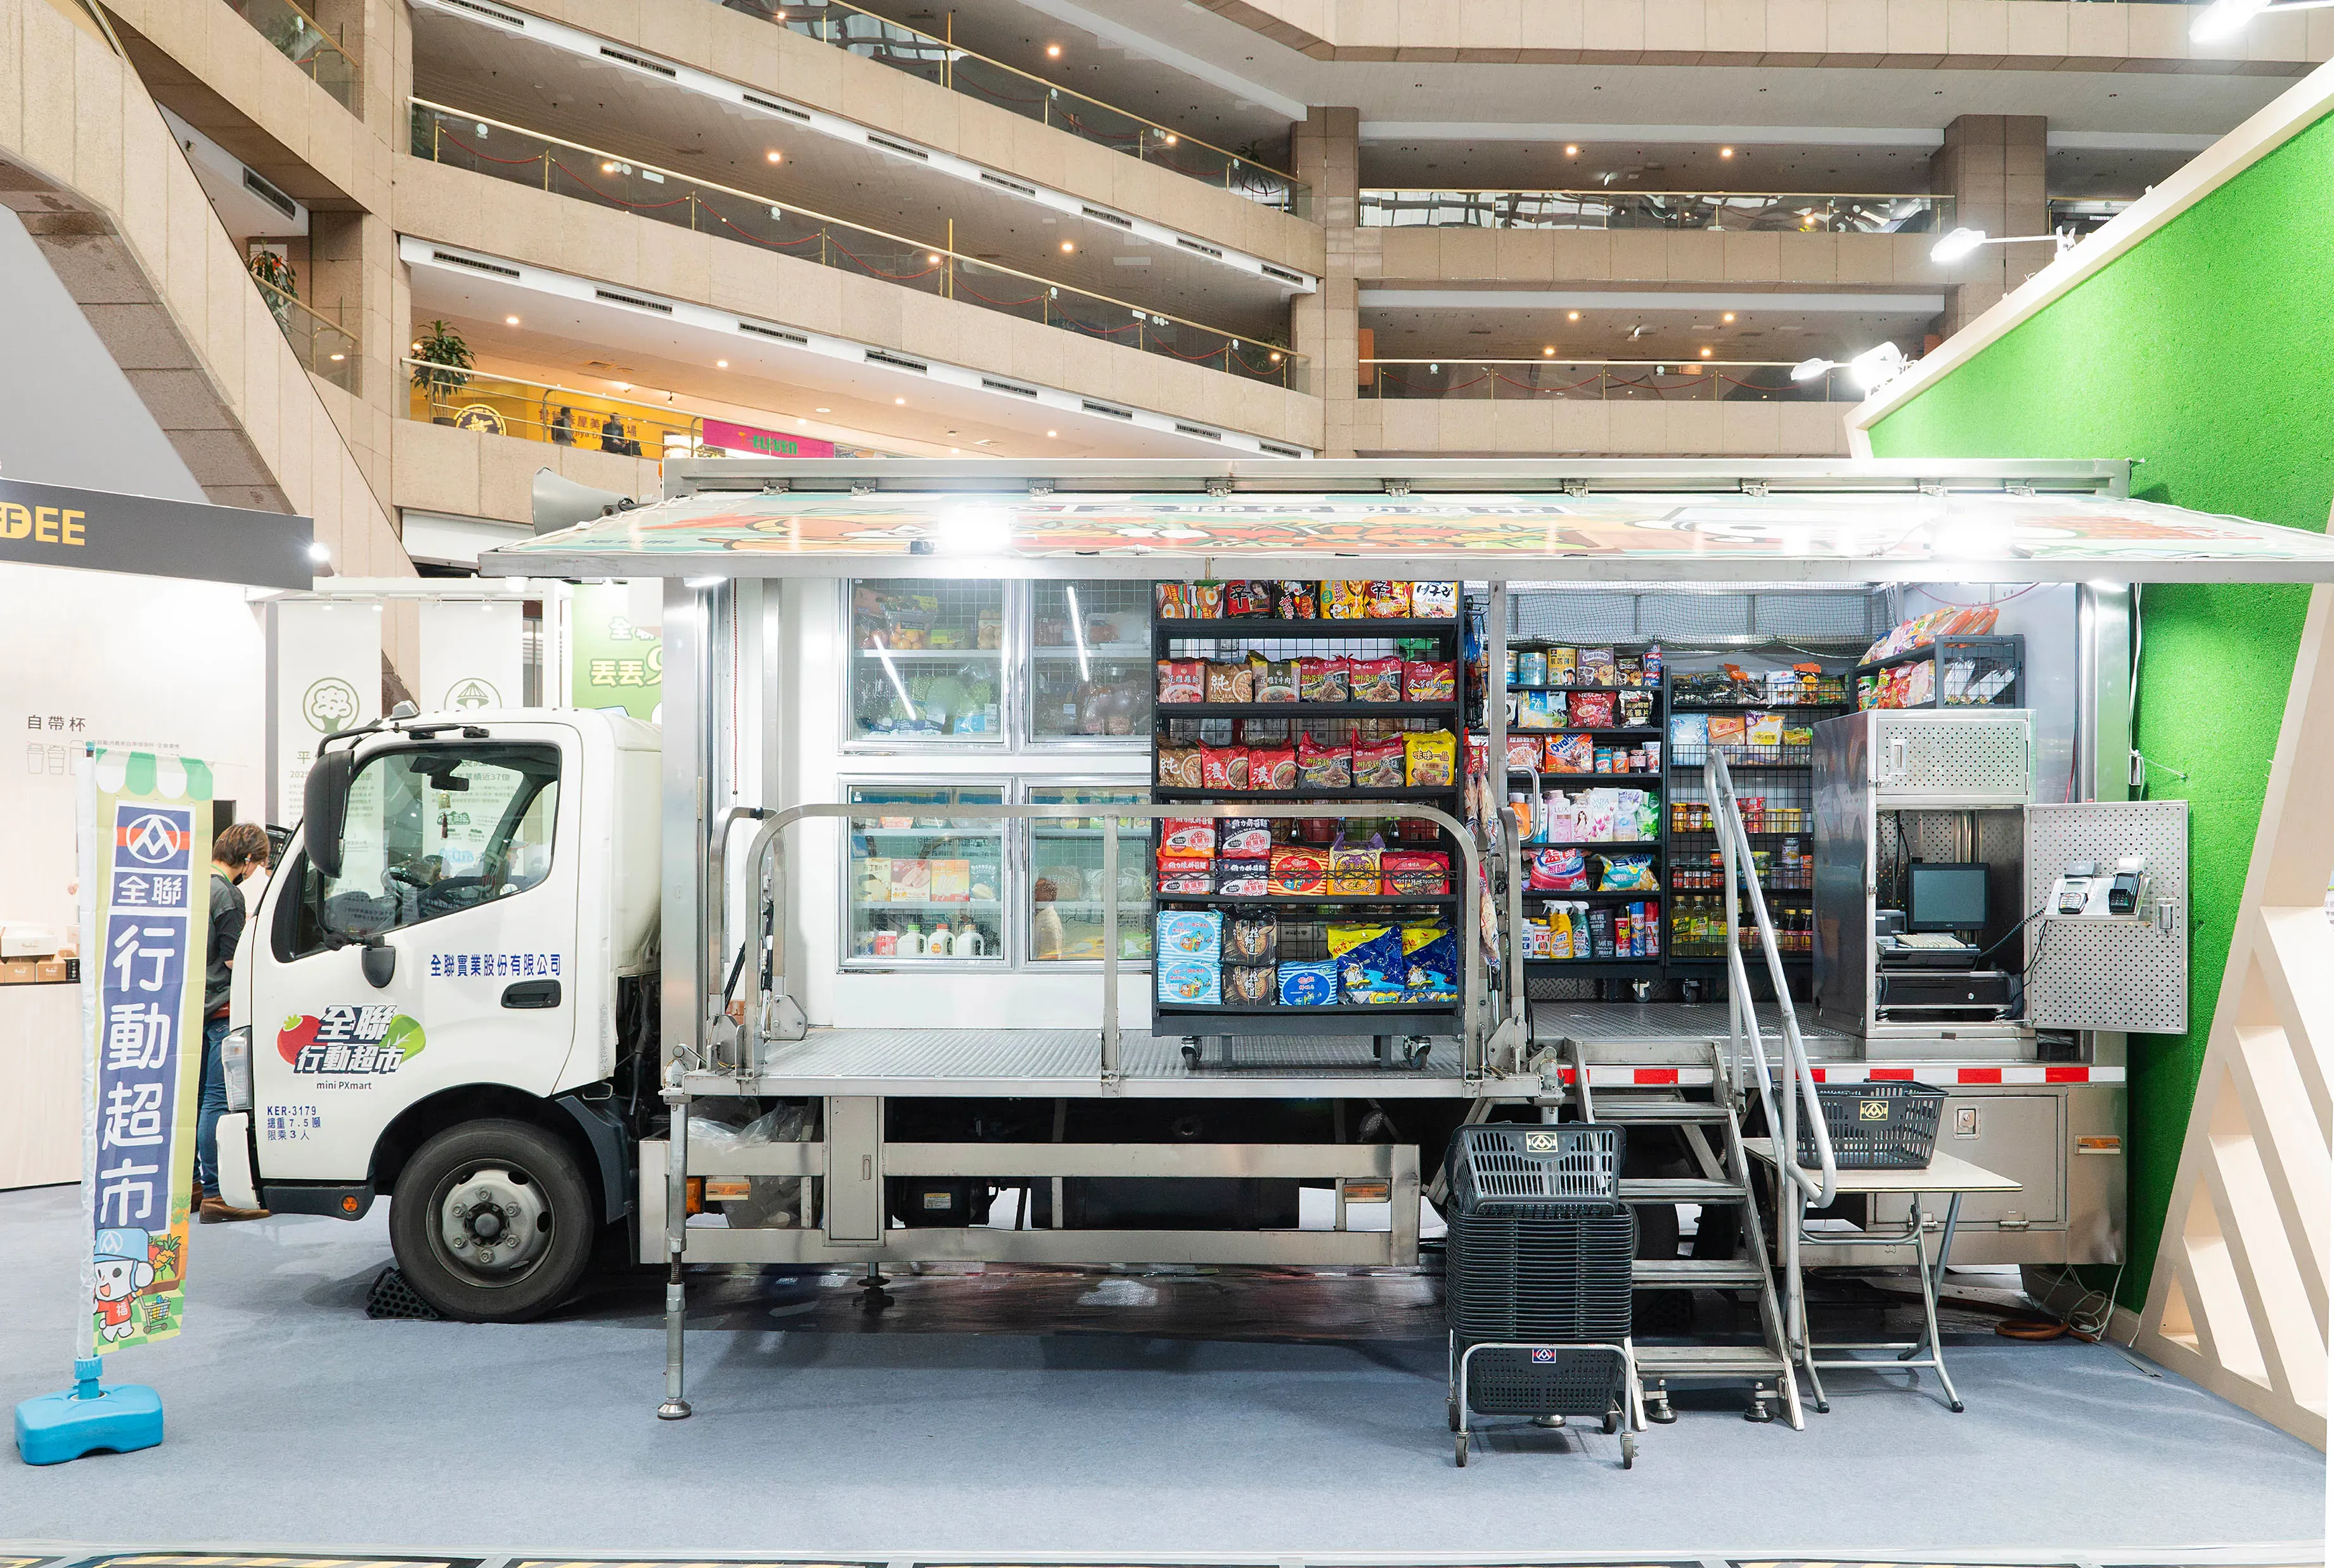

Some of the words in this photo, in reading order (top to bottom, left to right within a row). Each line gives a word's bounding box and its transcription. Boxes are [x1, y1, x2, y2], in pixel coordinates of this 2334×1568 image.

[1229, 583, 1251, 609] 辛
[1370, 580, 1390, 602] 辛
[1168, 674, 1201, 684] 花雕雞麵
[1211, 674, 1233, 693] 純
[27, 714, 86, 732] 自帶杯
[1159, 756, 1181, 775] 純
[1412, 750, 1450, 762] 味味一品
[1205, 761, 1225, 780] 濃
[1251, 766, 1272, 784] 濃
[117, 875, 183, 905] 全聯
[430, 953, 562, 977] 全聯實業股份有限公司
[313, 1005, 397, 1043] 全聯
[293, 1044, 406, 1074] 行動超市
[100, 924, 176, 1228] 行動超市
[316, 1081, 337, 1090] mini
[338, 1081, 372, 1090] PXmart
[267, 1105, 317, 1116] KER-3179
[115, 1302, 129, 1318] 福
